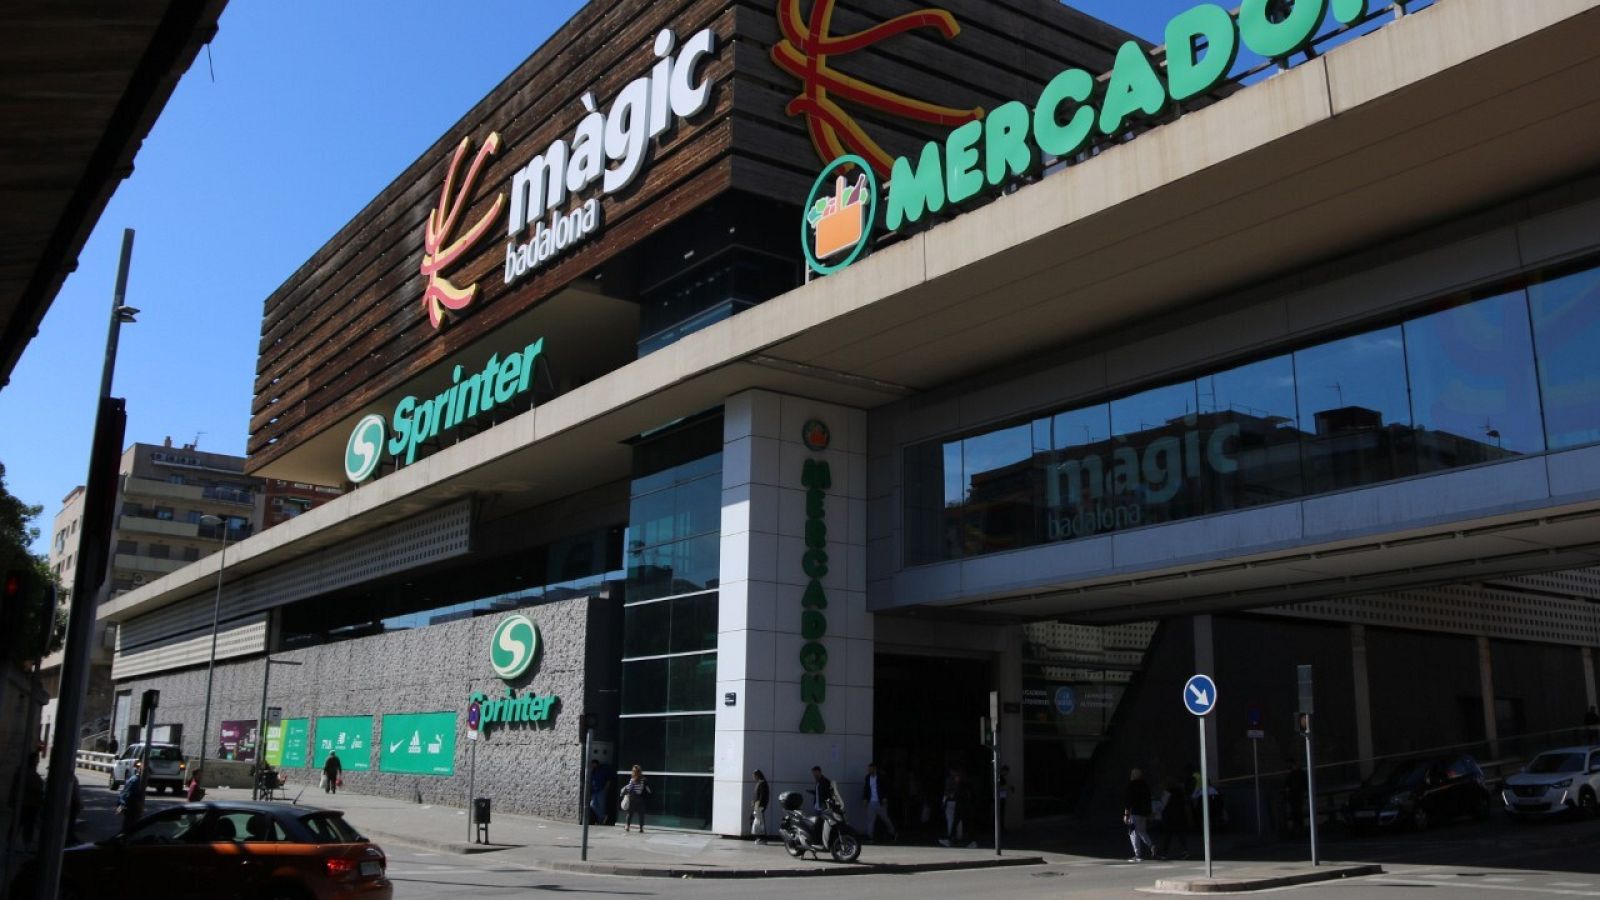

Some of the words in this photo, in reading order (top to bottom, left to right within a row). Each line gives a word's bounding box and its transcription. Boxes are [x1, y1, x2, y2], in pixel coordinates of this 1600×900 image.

[507, 28, 713, 237] màgic
[886, 0, 1367, 231] MERCADO
[503, 198, 598, 284] badalona
[389, 338, 544, 464] Sprinter
[799, 457, 831, 734] MERCADONA
[1047, 502, 1141, 540] badalona
